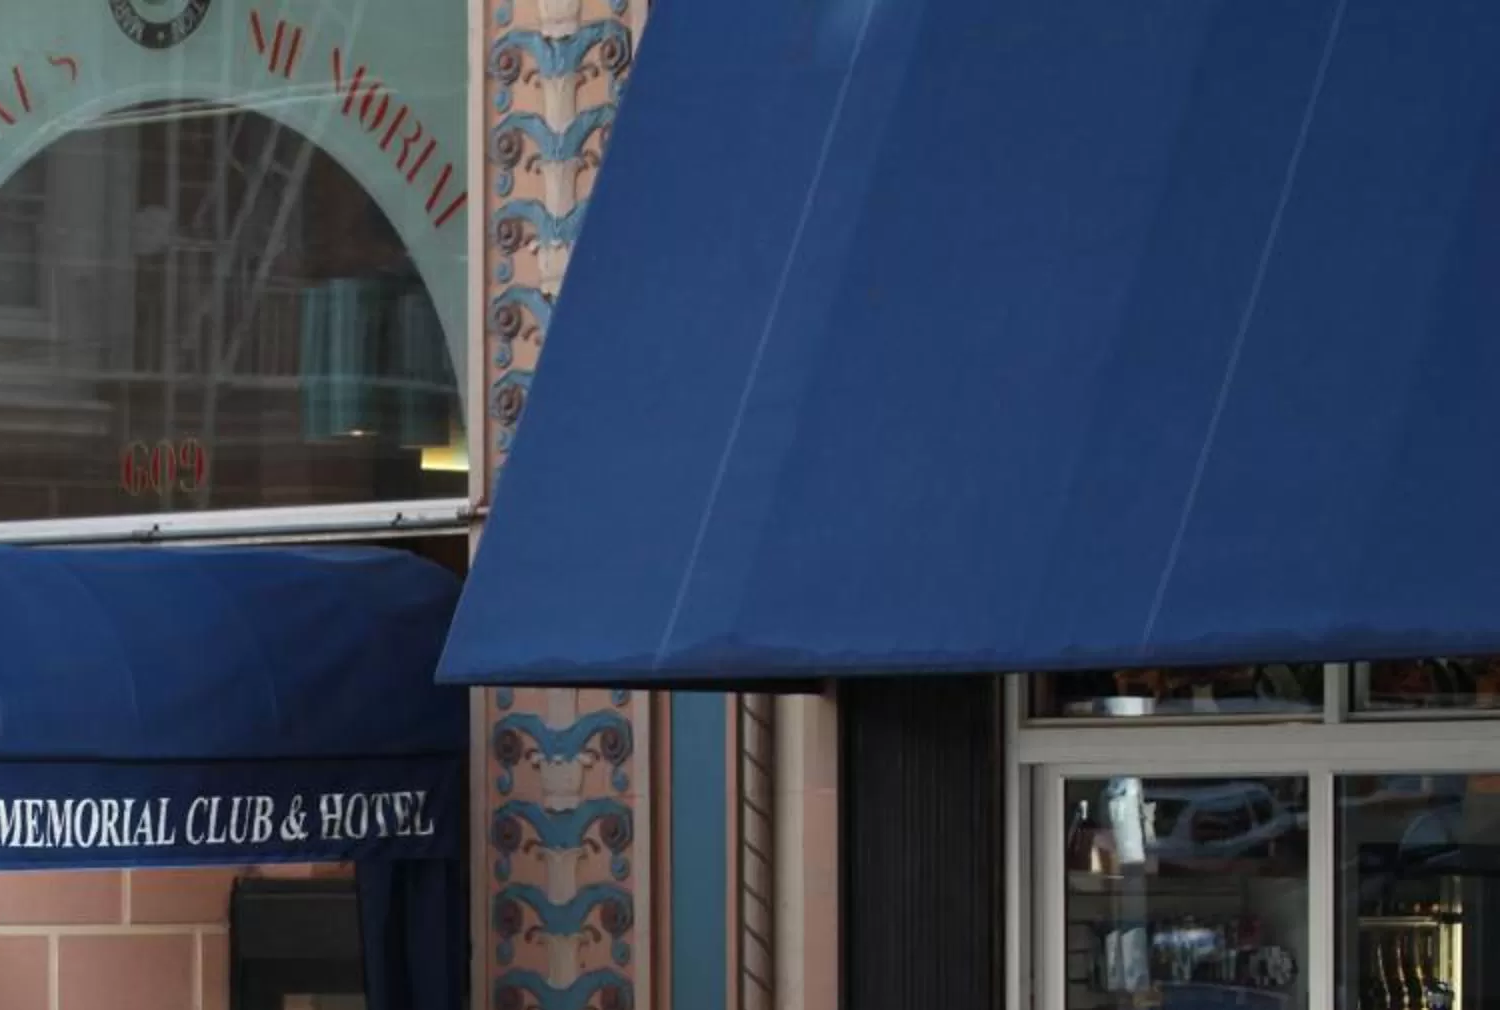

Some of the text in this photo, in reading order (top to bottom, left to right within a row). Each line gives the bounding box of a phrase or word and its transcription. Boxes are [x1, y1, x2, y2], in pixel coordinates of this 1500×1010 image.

[122, 437, 210, 497] 609
[185, 795, 275, 845] CLUB
[280, 794, 308, 841] &
[319, 790, 435, 840] HOTEL
